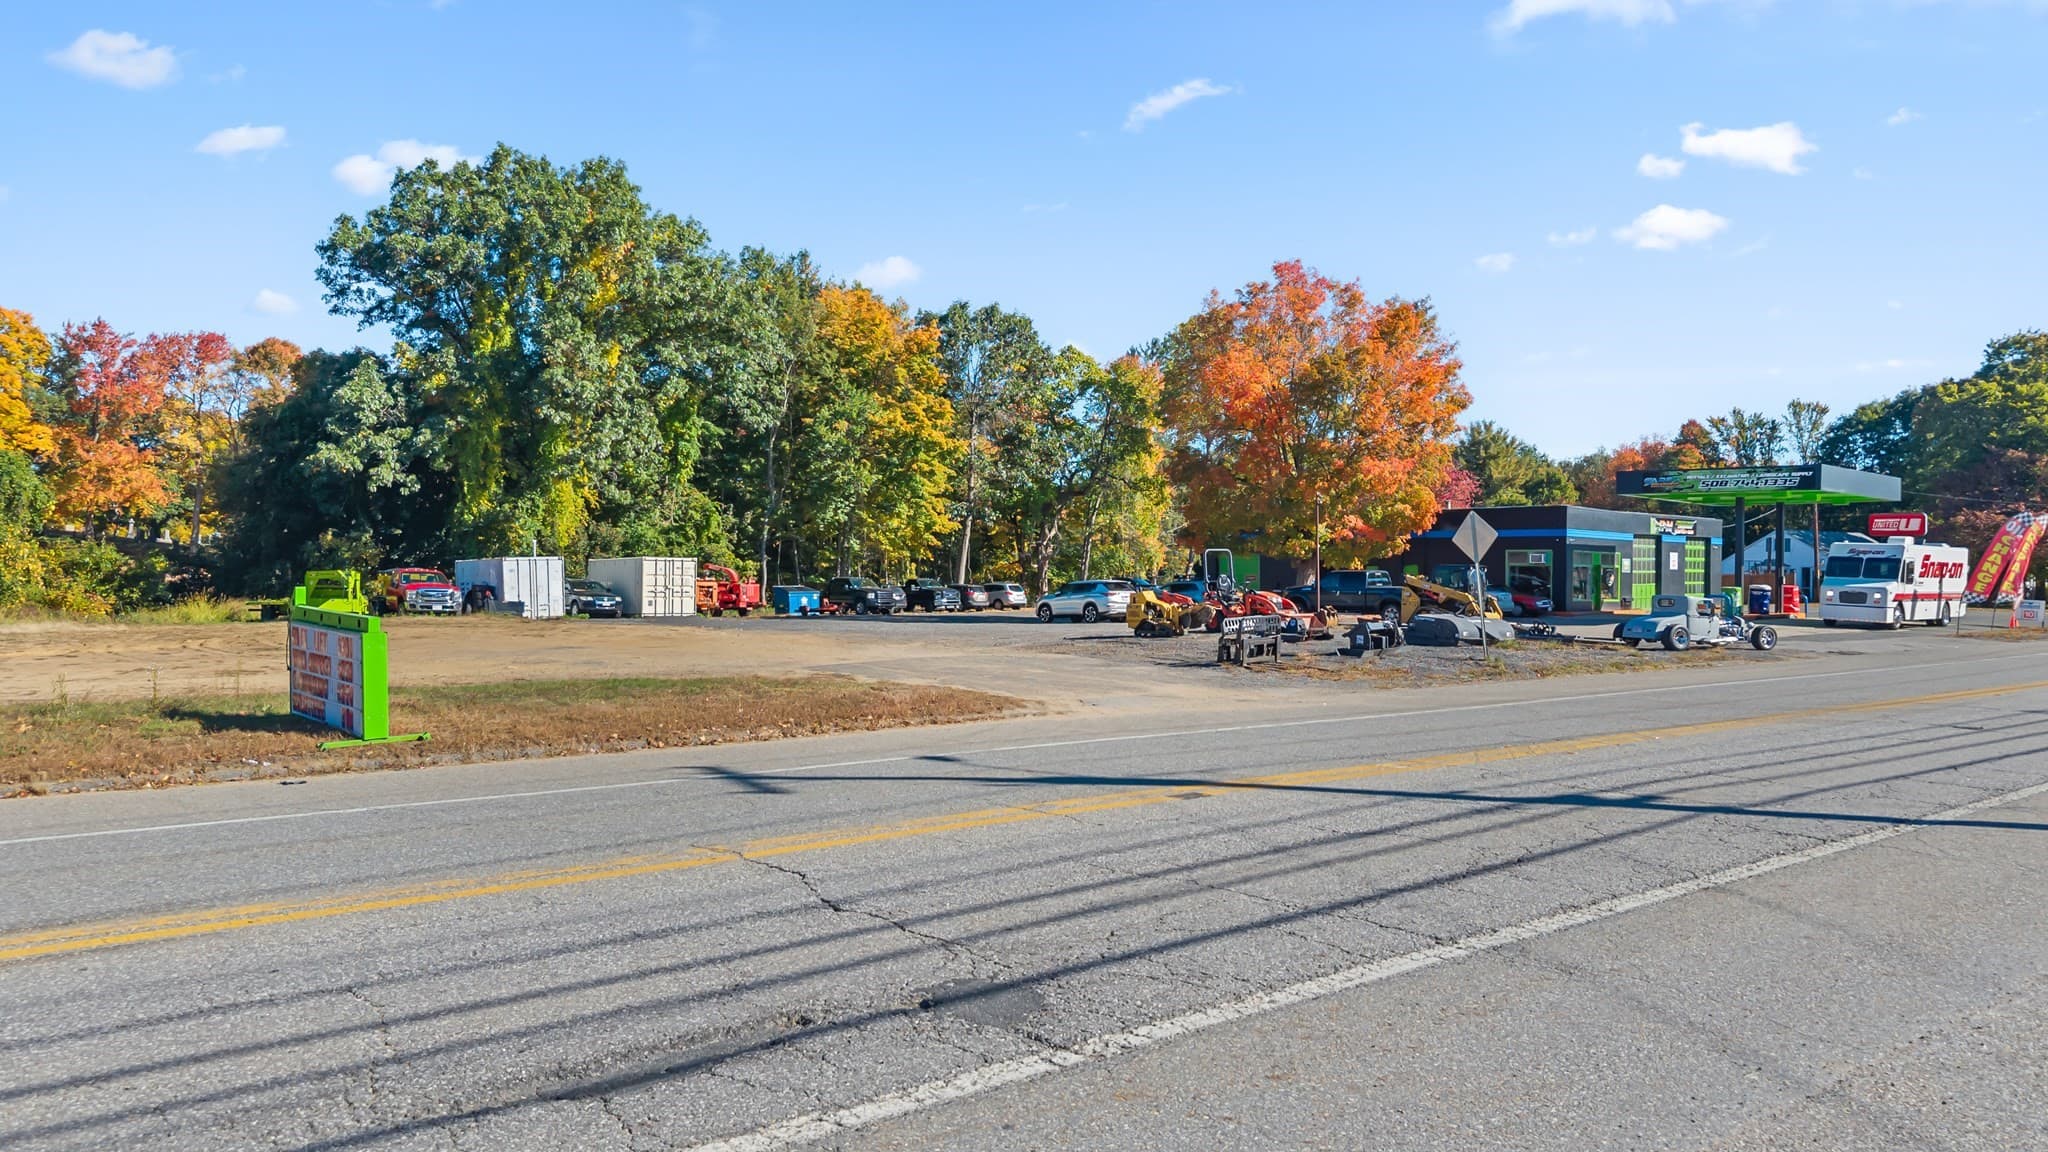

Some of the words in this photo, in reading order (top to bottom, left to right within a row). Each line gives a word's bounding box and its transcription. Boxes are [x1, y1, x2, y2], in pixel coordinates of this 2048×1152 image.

[1872, 519, 1900, 530] UNITED
[2005, 521, 2025, 537] OIL
[1918, 553, 1964, 580] Snap-on
[1973, 535, 2016, 593] CHANGE
